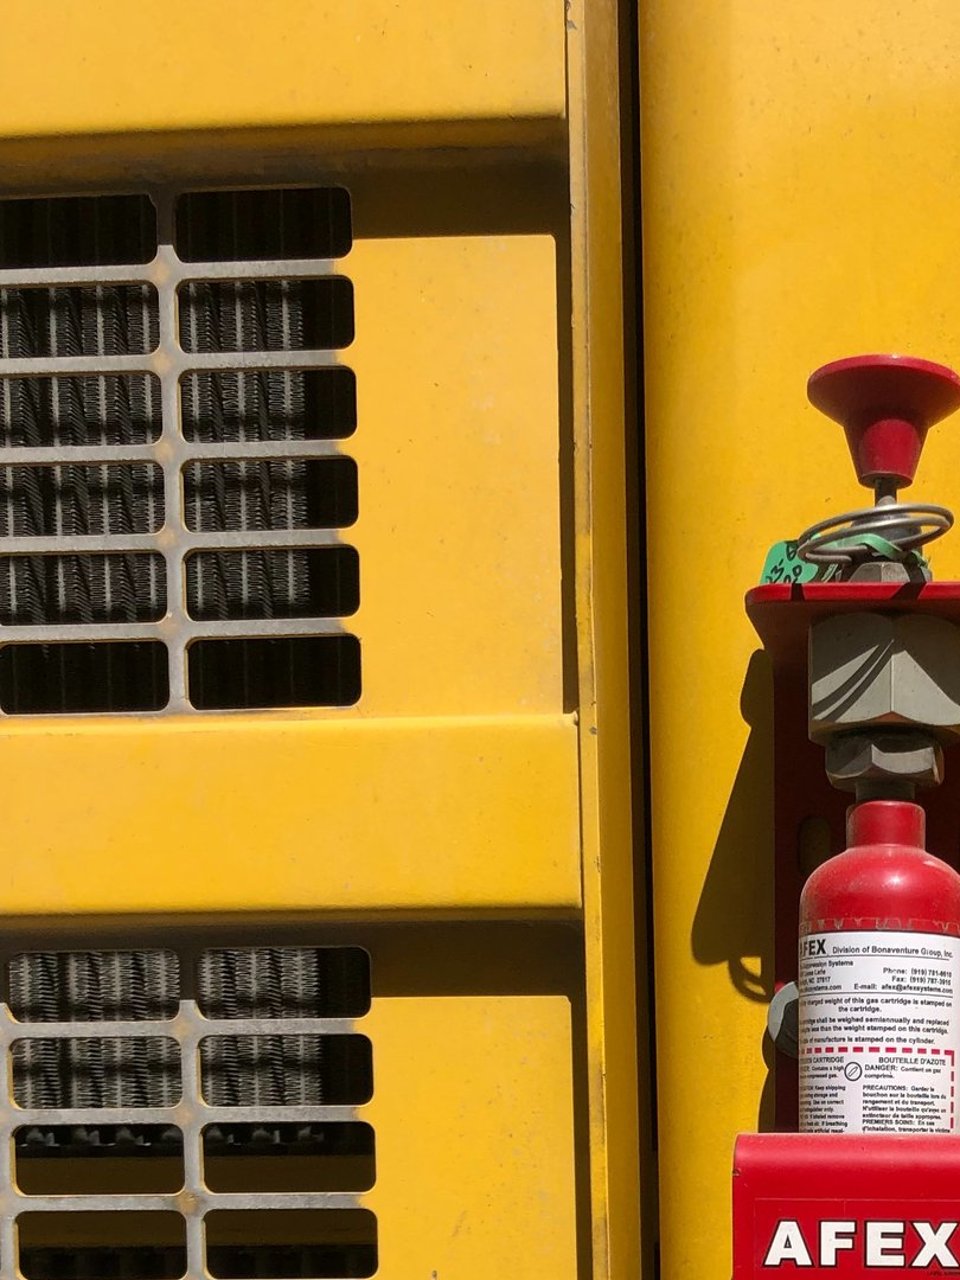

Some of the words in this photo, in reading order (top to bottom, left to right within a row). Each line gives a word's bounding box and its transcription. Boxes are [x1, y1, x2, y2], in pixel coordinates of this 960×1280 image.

[832, 946, 860, 954] Division
[861, 946, 870, 954] of
[871, 946, 919, 955] Bonaventure
[828, 960, 854, 968] Systems
[825, 998, 843, 1006] weight
[880, 998, 911, 1006] cartridge
[920, 999, 945, 1007] stamped
[837, 1016, 864, 1024] weighed
[926, 1018, 949, 1026] replaced
[854, 1036, 884, 1044] stamped
[878, 1056, 918, 1064] BOUTEILLE
[920, 1058, 946, 1066] D'AZOTE
